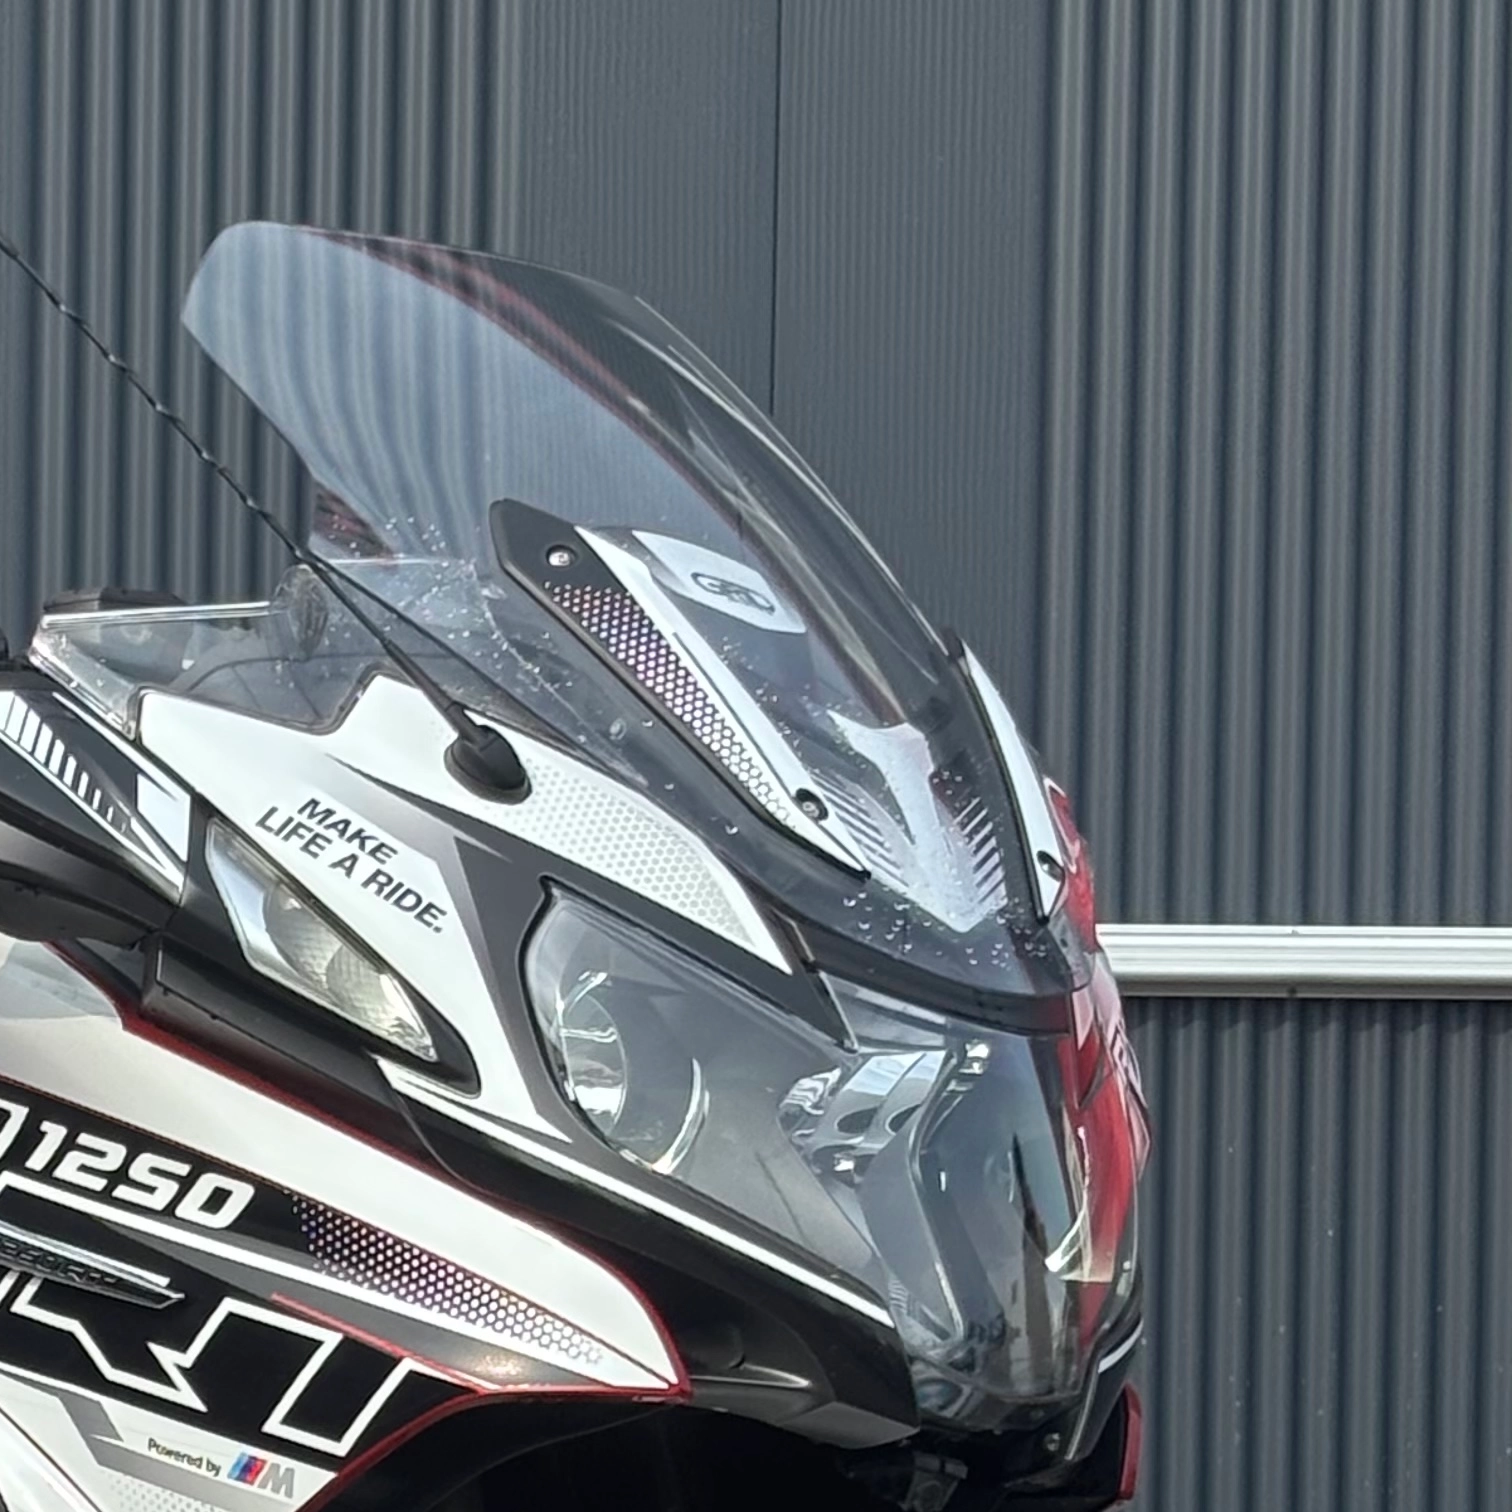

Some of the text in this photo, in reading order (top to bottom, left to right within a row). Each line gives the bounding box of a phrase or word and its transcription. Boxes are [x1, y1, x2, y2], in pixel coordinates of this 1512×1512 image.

[255, 806, 448, 933] LIFE A RIDE.
[297, 798, 398, 865] MAKE
[25, 1121, 255, 1230] 1250
[148, 1437, 203, 1469] Powered
[205, 1457, 222, 1478] by
